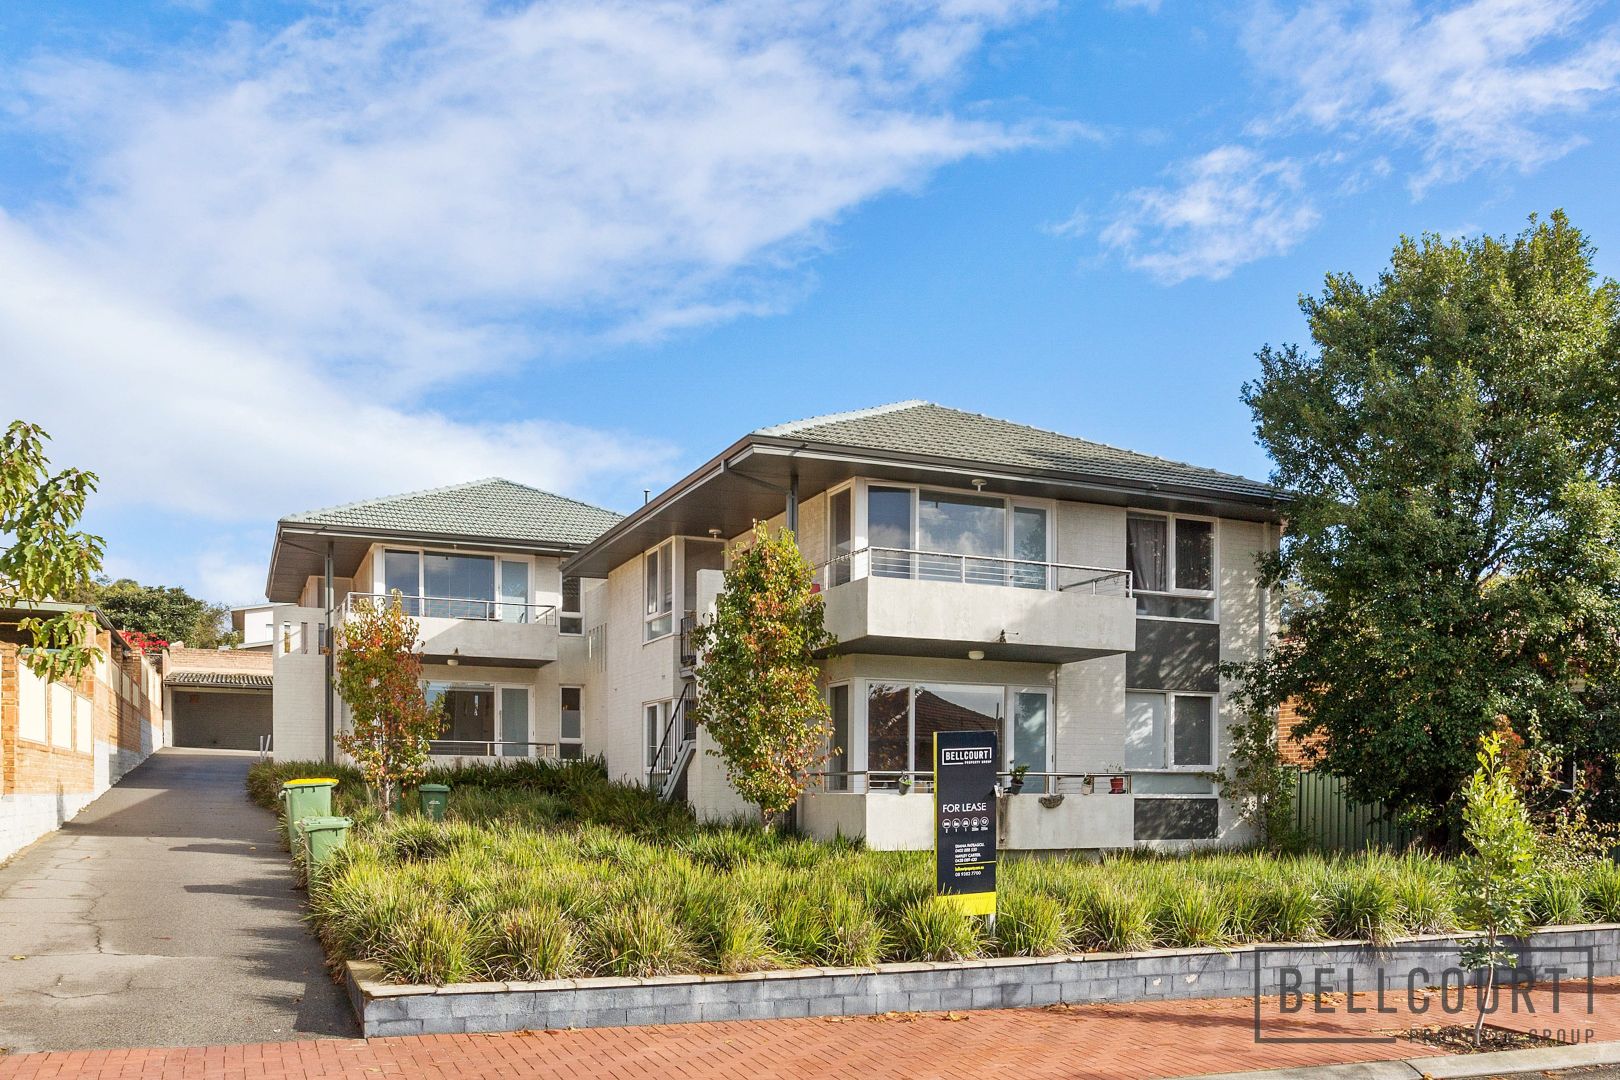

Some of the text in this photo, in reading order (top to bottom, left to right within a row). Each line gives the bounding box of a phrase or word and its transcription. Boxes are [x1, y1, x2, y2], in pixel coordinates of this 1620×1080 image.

[945, 750, 989, 761] BELLCOURT
[942, 802, 987, 813] FOR LEASE
